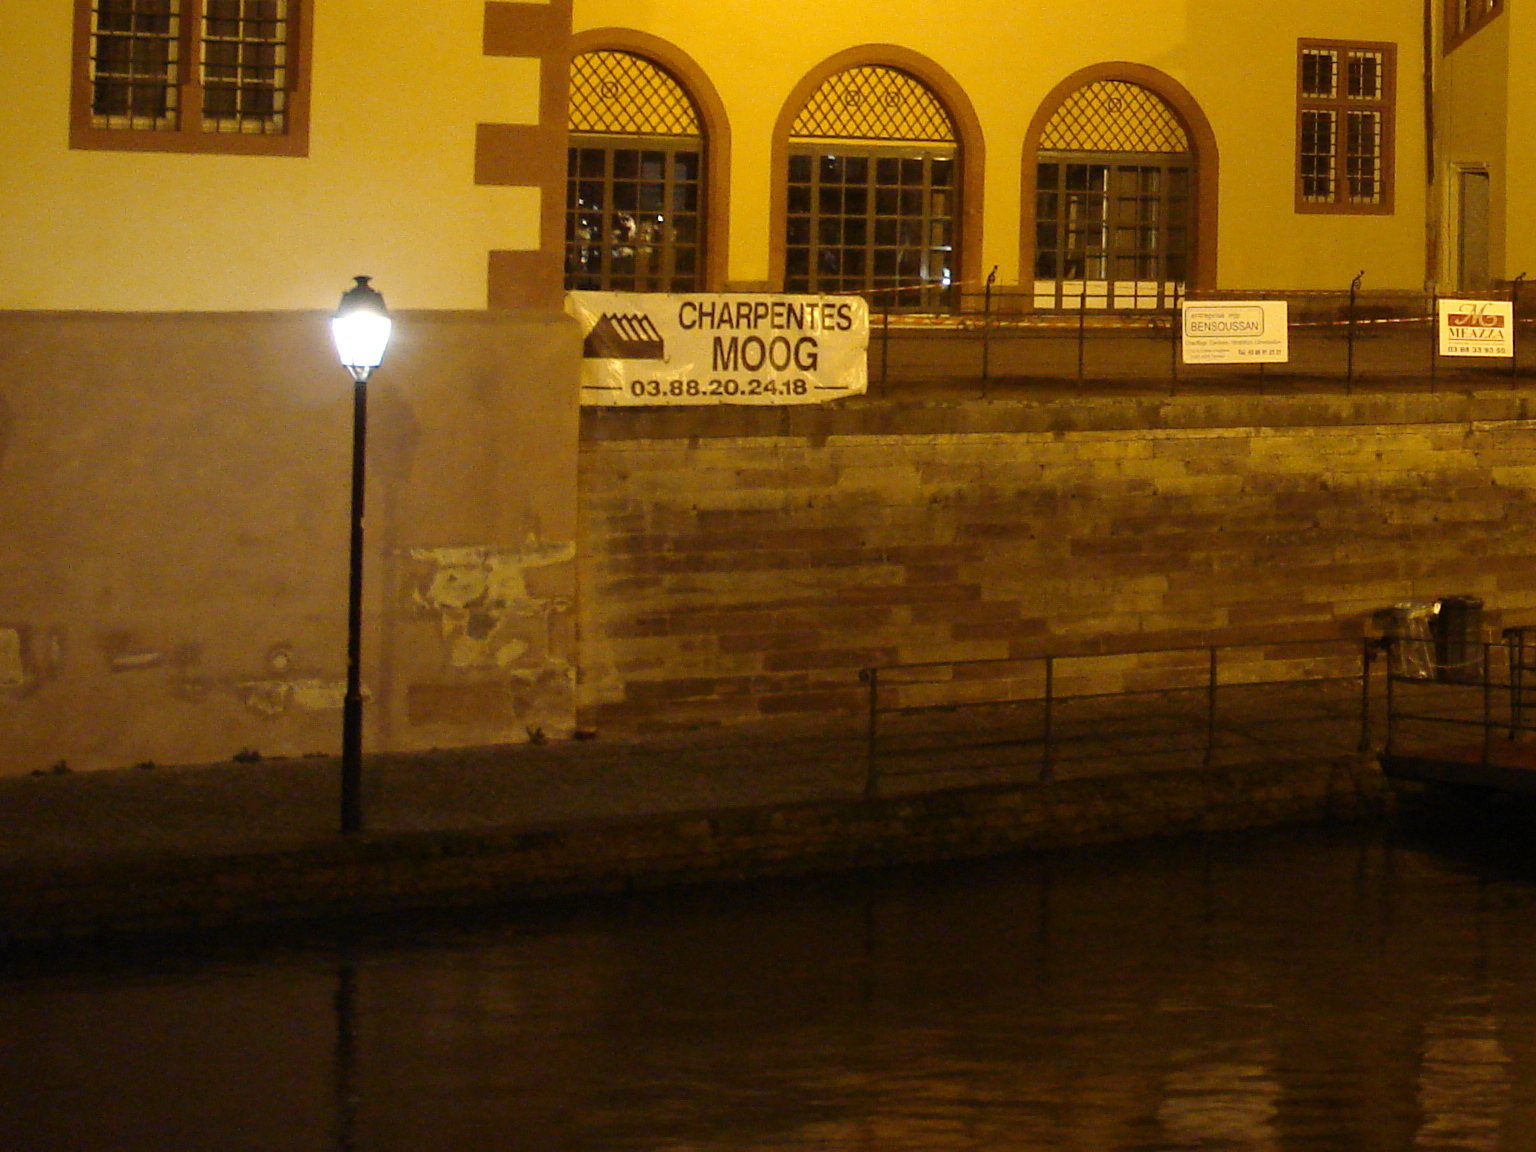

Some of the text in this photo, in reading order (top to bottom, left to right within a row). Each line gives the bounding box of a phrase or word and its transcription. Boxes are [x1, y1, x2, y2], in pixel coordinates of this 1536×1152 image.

[678, 301, 853, 332] CHARPENTES
[1190, 321, 1259, 332] BENSOUSSAN
[1448, 328, 1505, 339] MEAZZA
[712, 336, 818, 372] MOOG
[631, 378, 808, 397] 03.88.20.24.18
